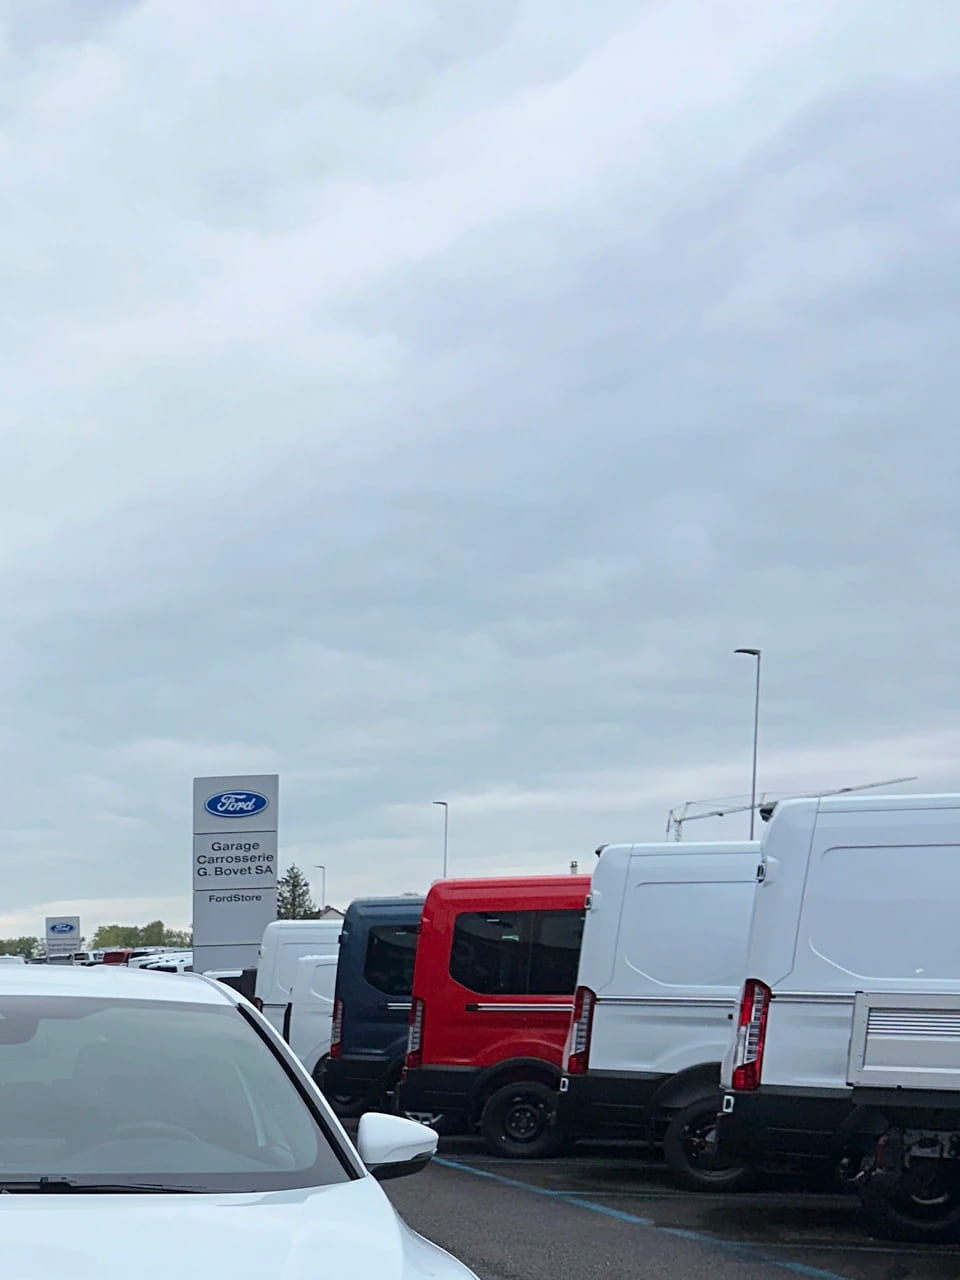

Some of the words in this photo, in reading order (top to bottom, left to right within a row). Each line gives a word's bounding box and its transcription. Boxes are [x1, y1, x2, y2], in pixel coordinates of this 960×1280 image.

[216, 794, 257, 812] Ford
[211, 841, 260, 852] Garage
[197, 853, 274, 865] Carrosserie
[197, 867, 211, 877] G.
[215, 866, 252, 876] Bovet
[255, 865, 273, 875] SA
[209, 893, 262, 903] FordStore
